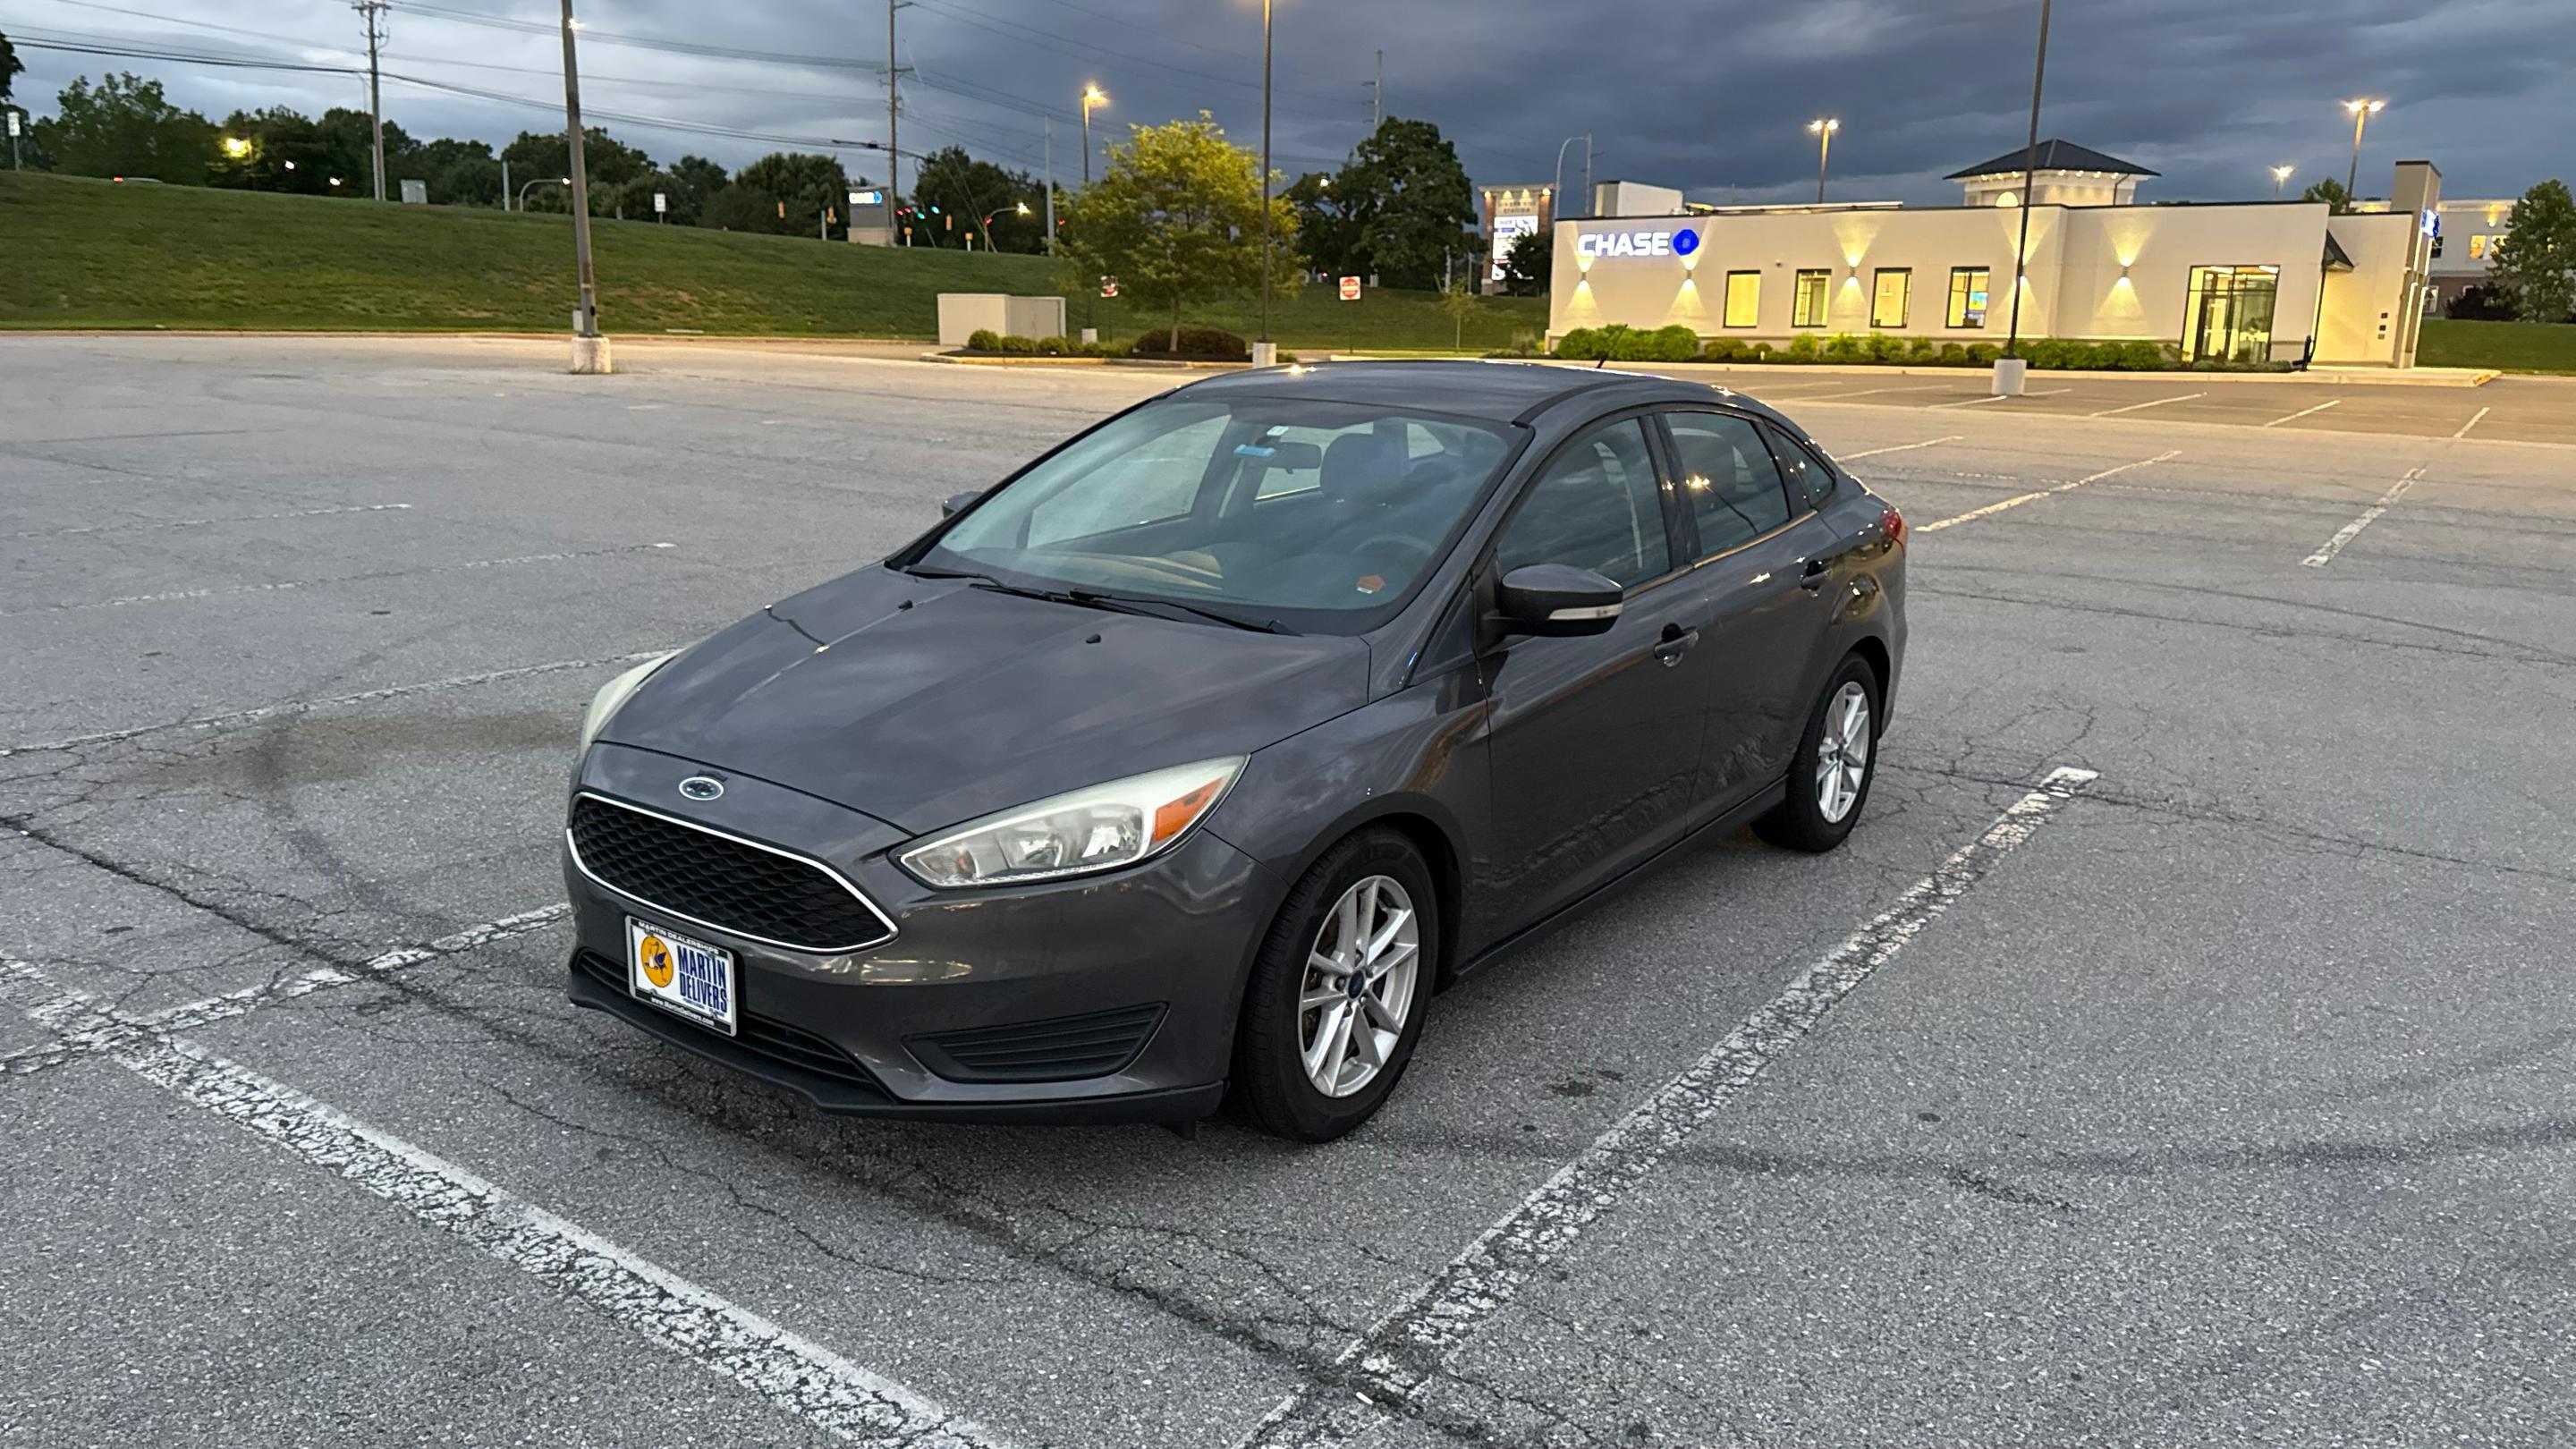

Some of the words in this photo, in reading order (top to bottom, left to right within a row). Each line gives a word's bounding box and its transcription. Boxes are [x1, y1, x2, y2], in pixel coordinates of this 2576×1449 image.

[1578, 232, 1670, 257] CHASE
[639, 921, 667, 936] MARTIN
[667, 932, 719, 954] DEALERSHIPS
[677, 945, 726, 988] MARTIN
[679, 973, 727, 1013] DELIVERS
